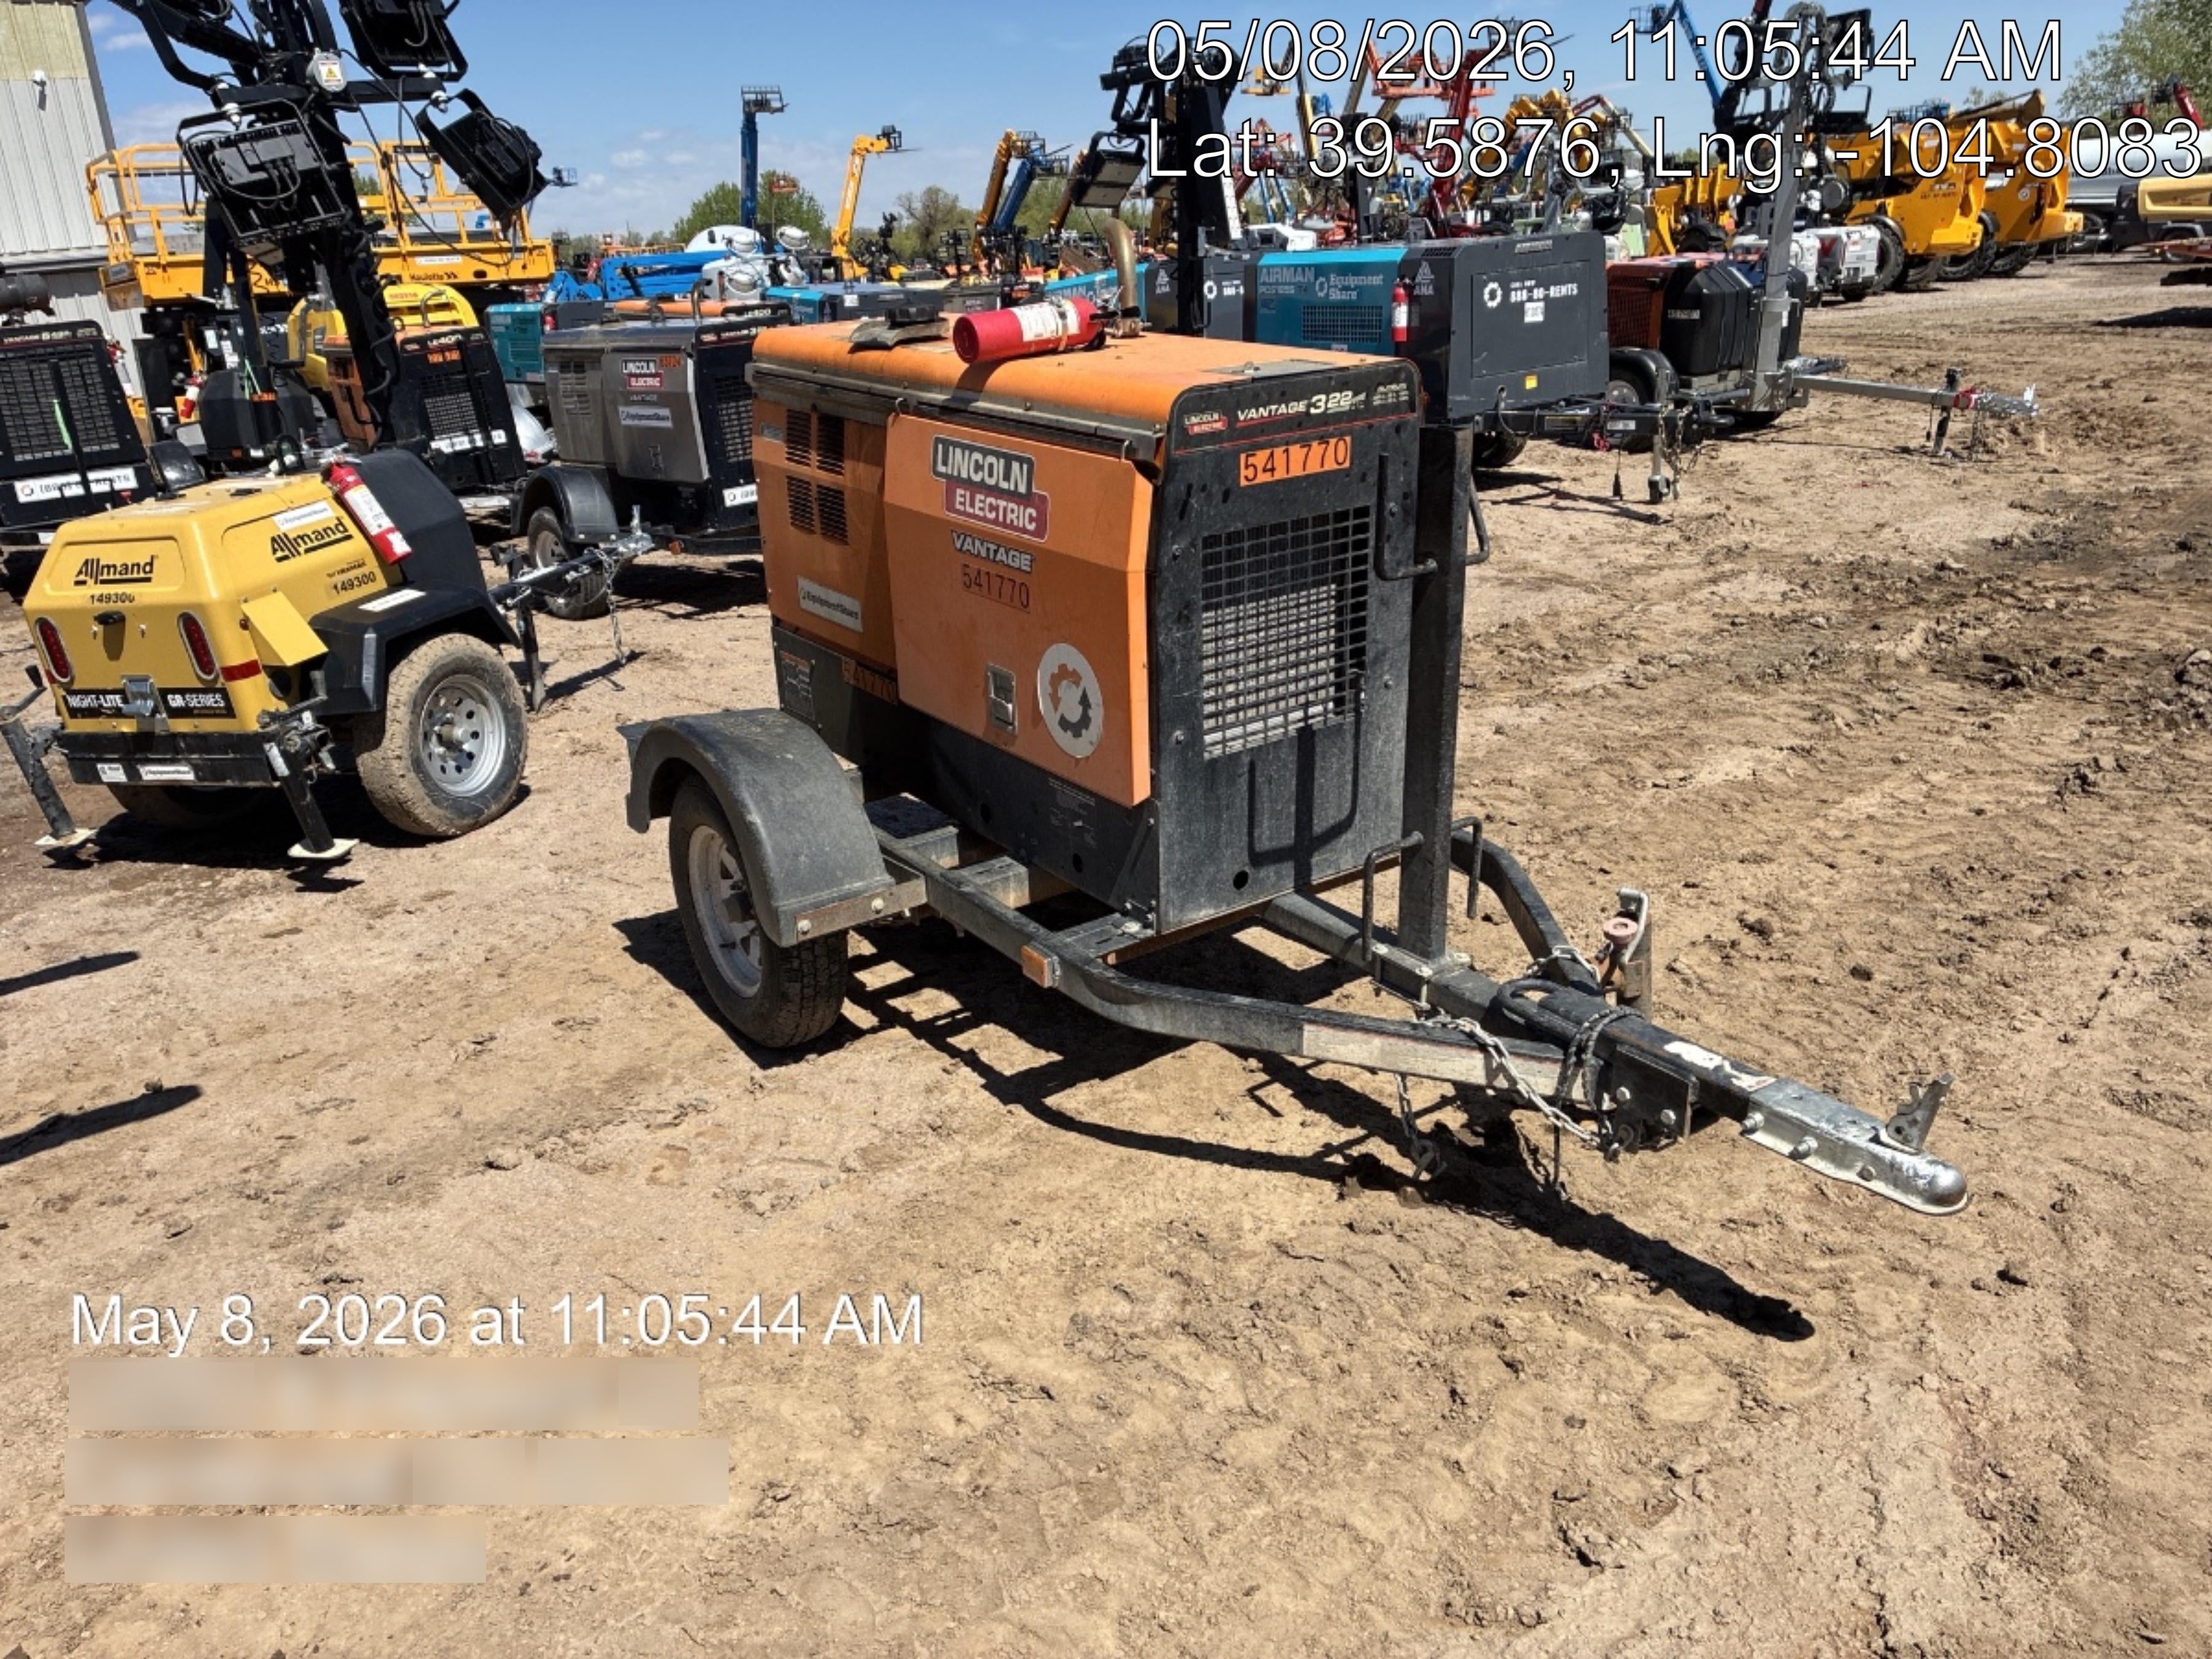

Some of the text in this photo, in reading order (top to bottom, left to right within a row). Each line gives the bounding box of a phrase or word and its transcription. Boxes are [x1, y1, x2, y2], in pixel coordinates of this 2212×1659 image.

[1260, 266, 1315, 283] AIRMAN
[1329, 274, 1384, 285] Equipment
[1328, 288, 1357, 299] Share
[622, 360, 655, 374] LINCOLN
[1184, 412, 1220, 425] LINCOLN
[1236, 399, 1308, 421] VANTAGE
[1309, 390, 1352, 415] 322
[938, 444, 1028, 494] LINCOLN
[1244, 437, 1348, 483] 541770
[955, 488, 1037, 531] ELECTRIC
[271, 517, 350, 559] Allmand
[952, 530, 1033, 573] VANTAGE
[75, 554, 154, 585] Allmand
[332, 571, 377, 595] 149300
[962, 563, 1030, 609] 541770
[66, 694, 124, 708] NIGHT-LITE
